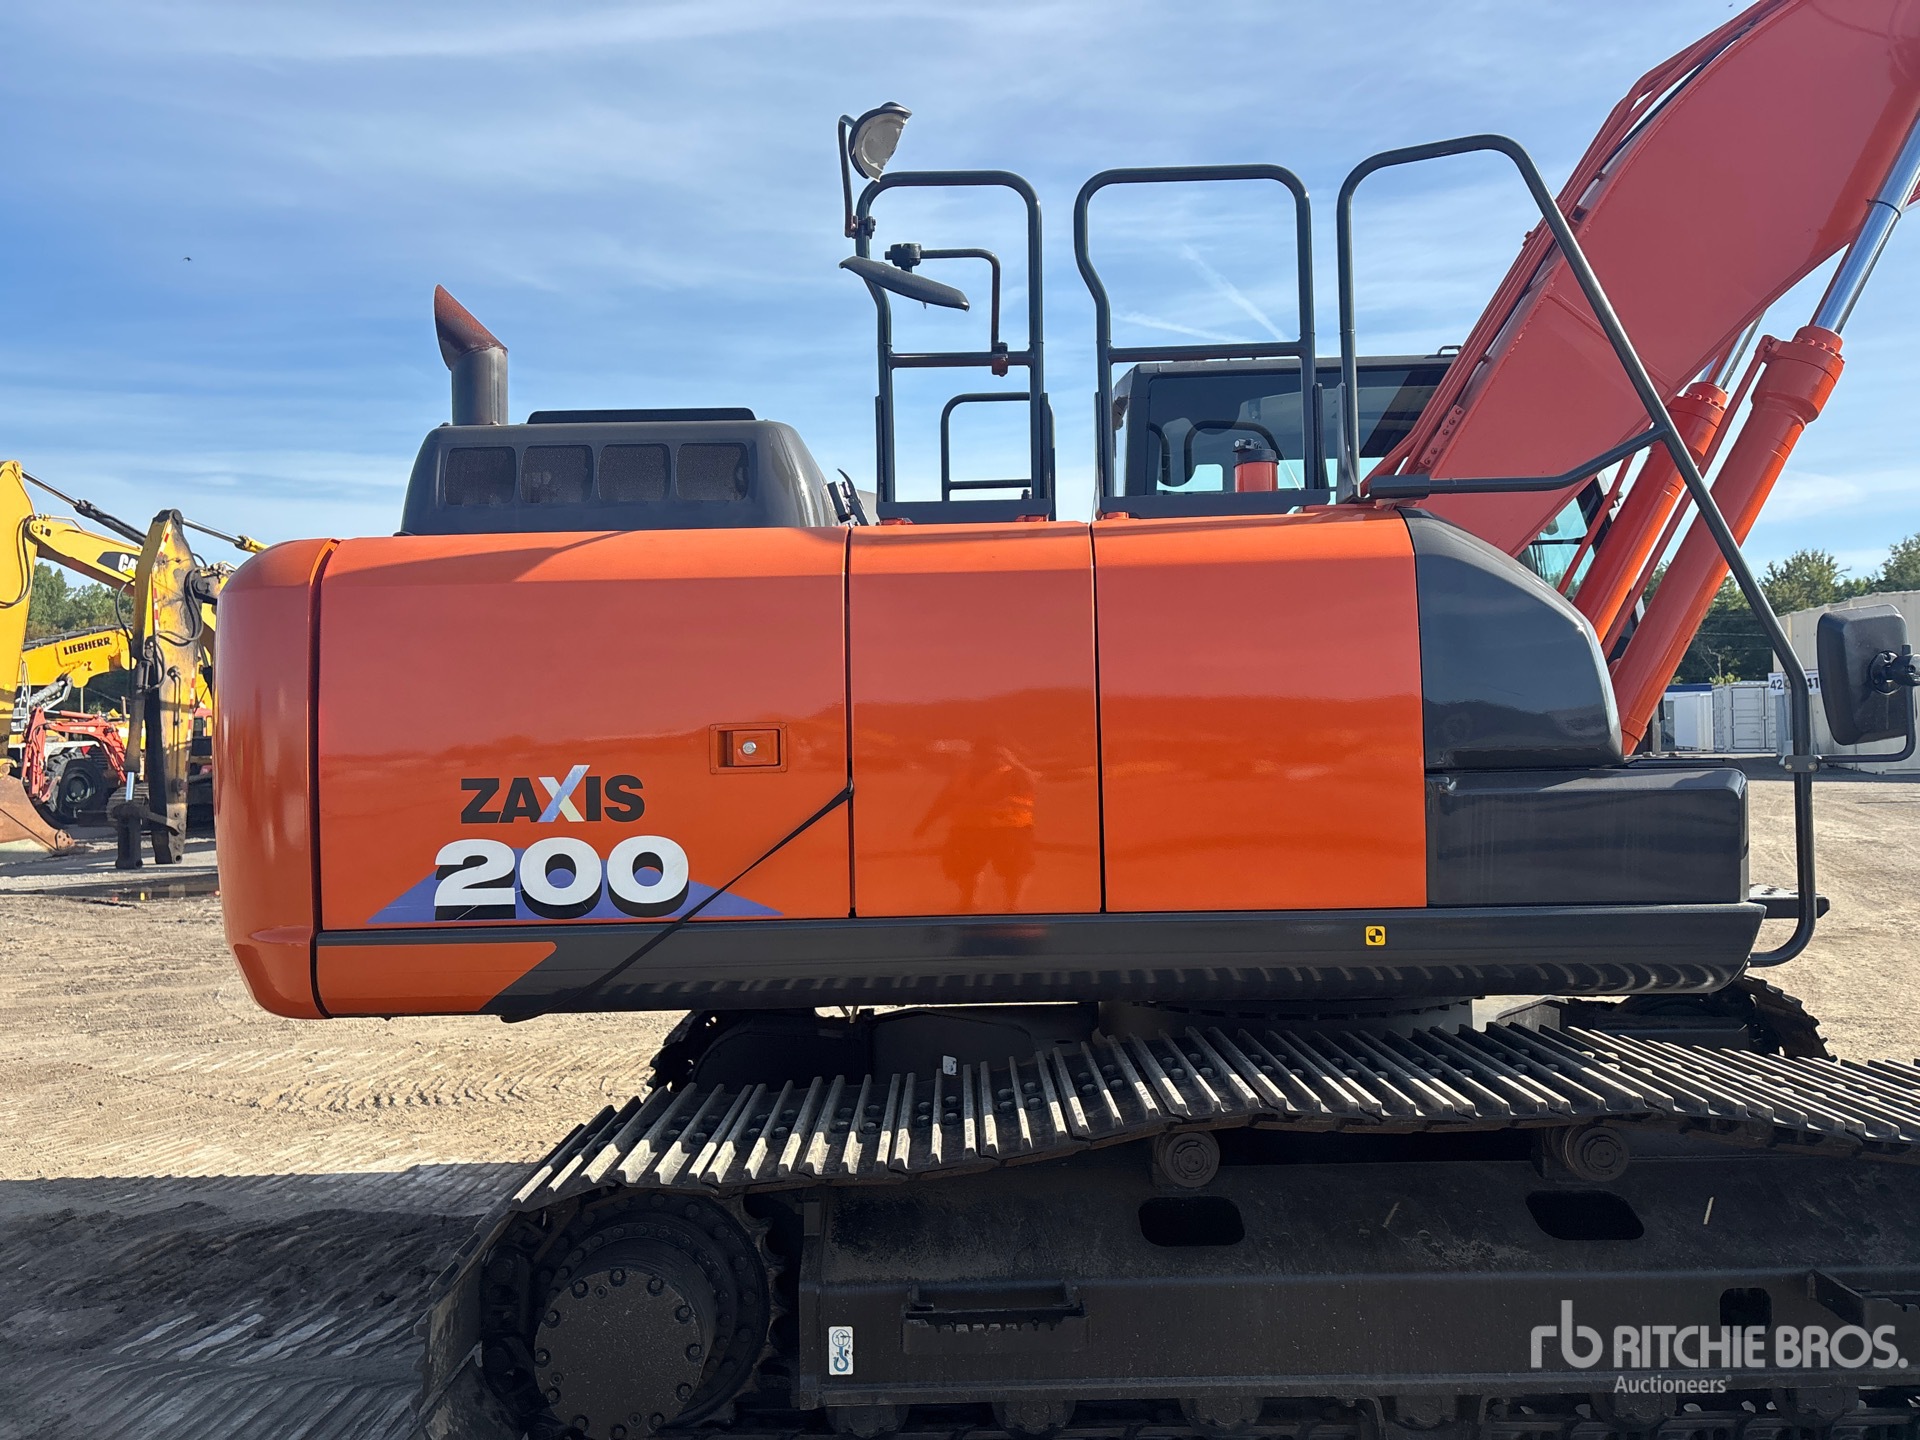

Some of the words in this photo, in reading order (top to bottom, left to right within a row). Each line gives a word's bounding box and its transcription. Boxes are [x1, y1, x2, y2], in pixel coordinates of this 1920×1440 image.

[118, 554, 138, 572] CA
[64, 637, 111, 655] LIEBHERR
[1770, 679, 1783, 690] 42
[461, 765, 645, 824] ZAXIS
[434, 835, 689, 919] 200
